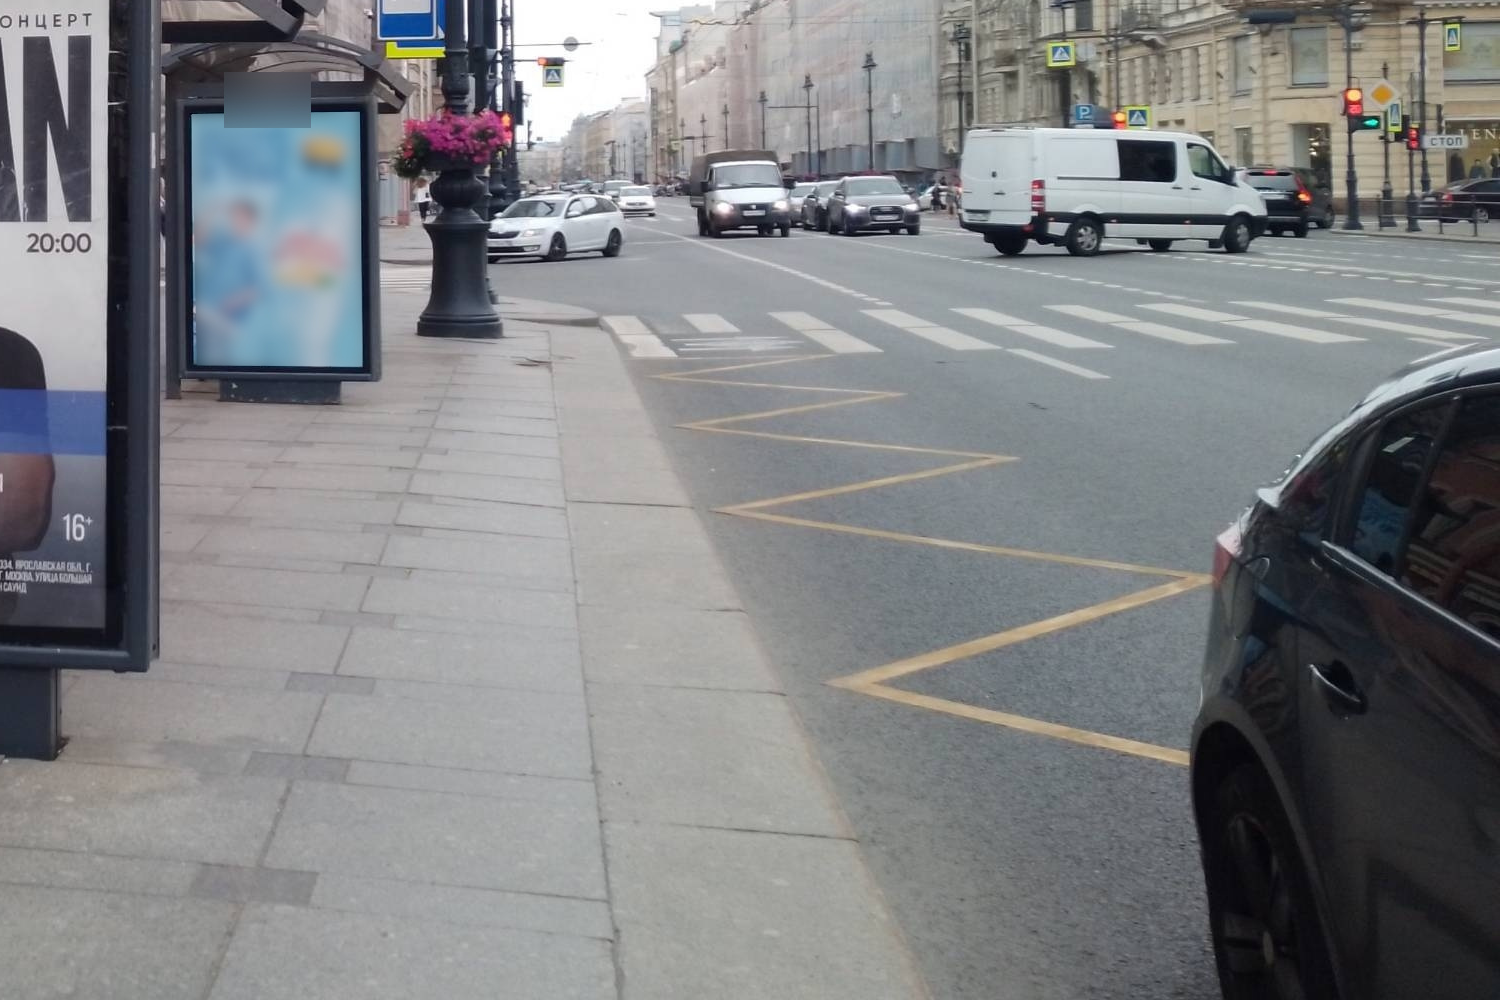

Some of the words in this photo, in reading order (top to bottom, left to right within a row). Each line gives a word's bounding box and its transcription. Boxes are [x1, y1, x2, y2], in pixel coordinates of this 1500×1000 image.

[1430, 137, 1463, 146] СТОП
[27, 233, 92, 253] 20:00
[62, 513, 93, 541] 16+
